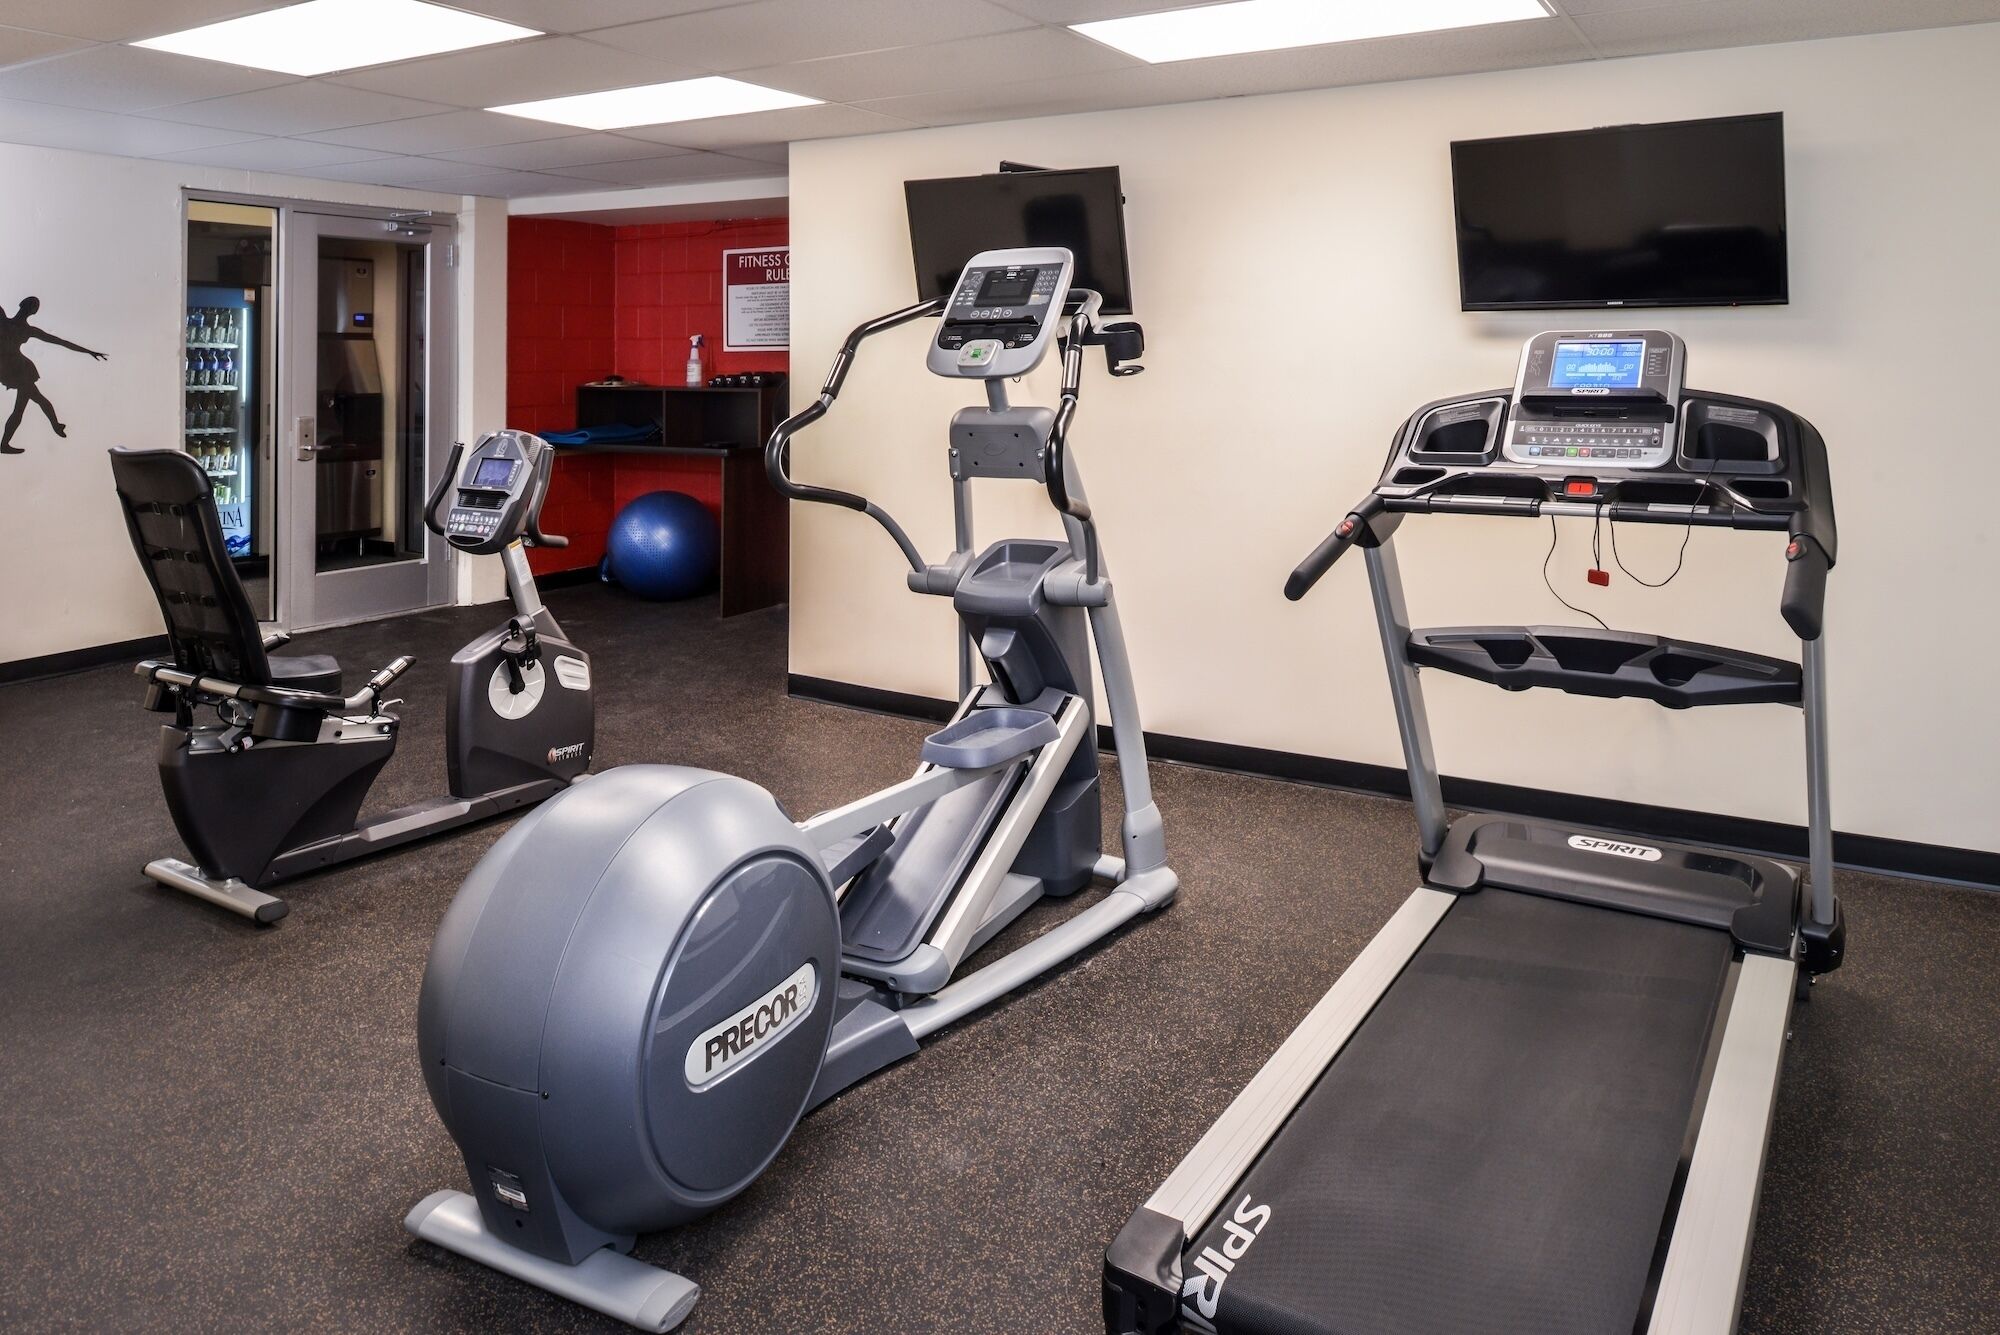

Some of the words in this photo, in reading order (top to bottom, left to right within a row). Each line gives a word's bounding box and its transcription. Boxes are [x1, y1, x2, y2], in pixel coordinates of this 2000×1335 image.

[738, 254, 781, 268] FITNESS
[554, 750, 582, 762] FITNESS
[555, 742, 585, 757] SPIRIT
[1576, 838, 1653, 857] SPIRIT
[705, 983, 798, 1073] PRECOR
